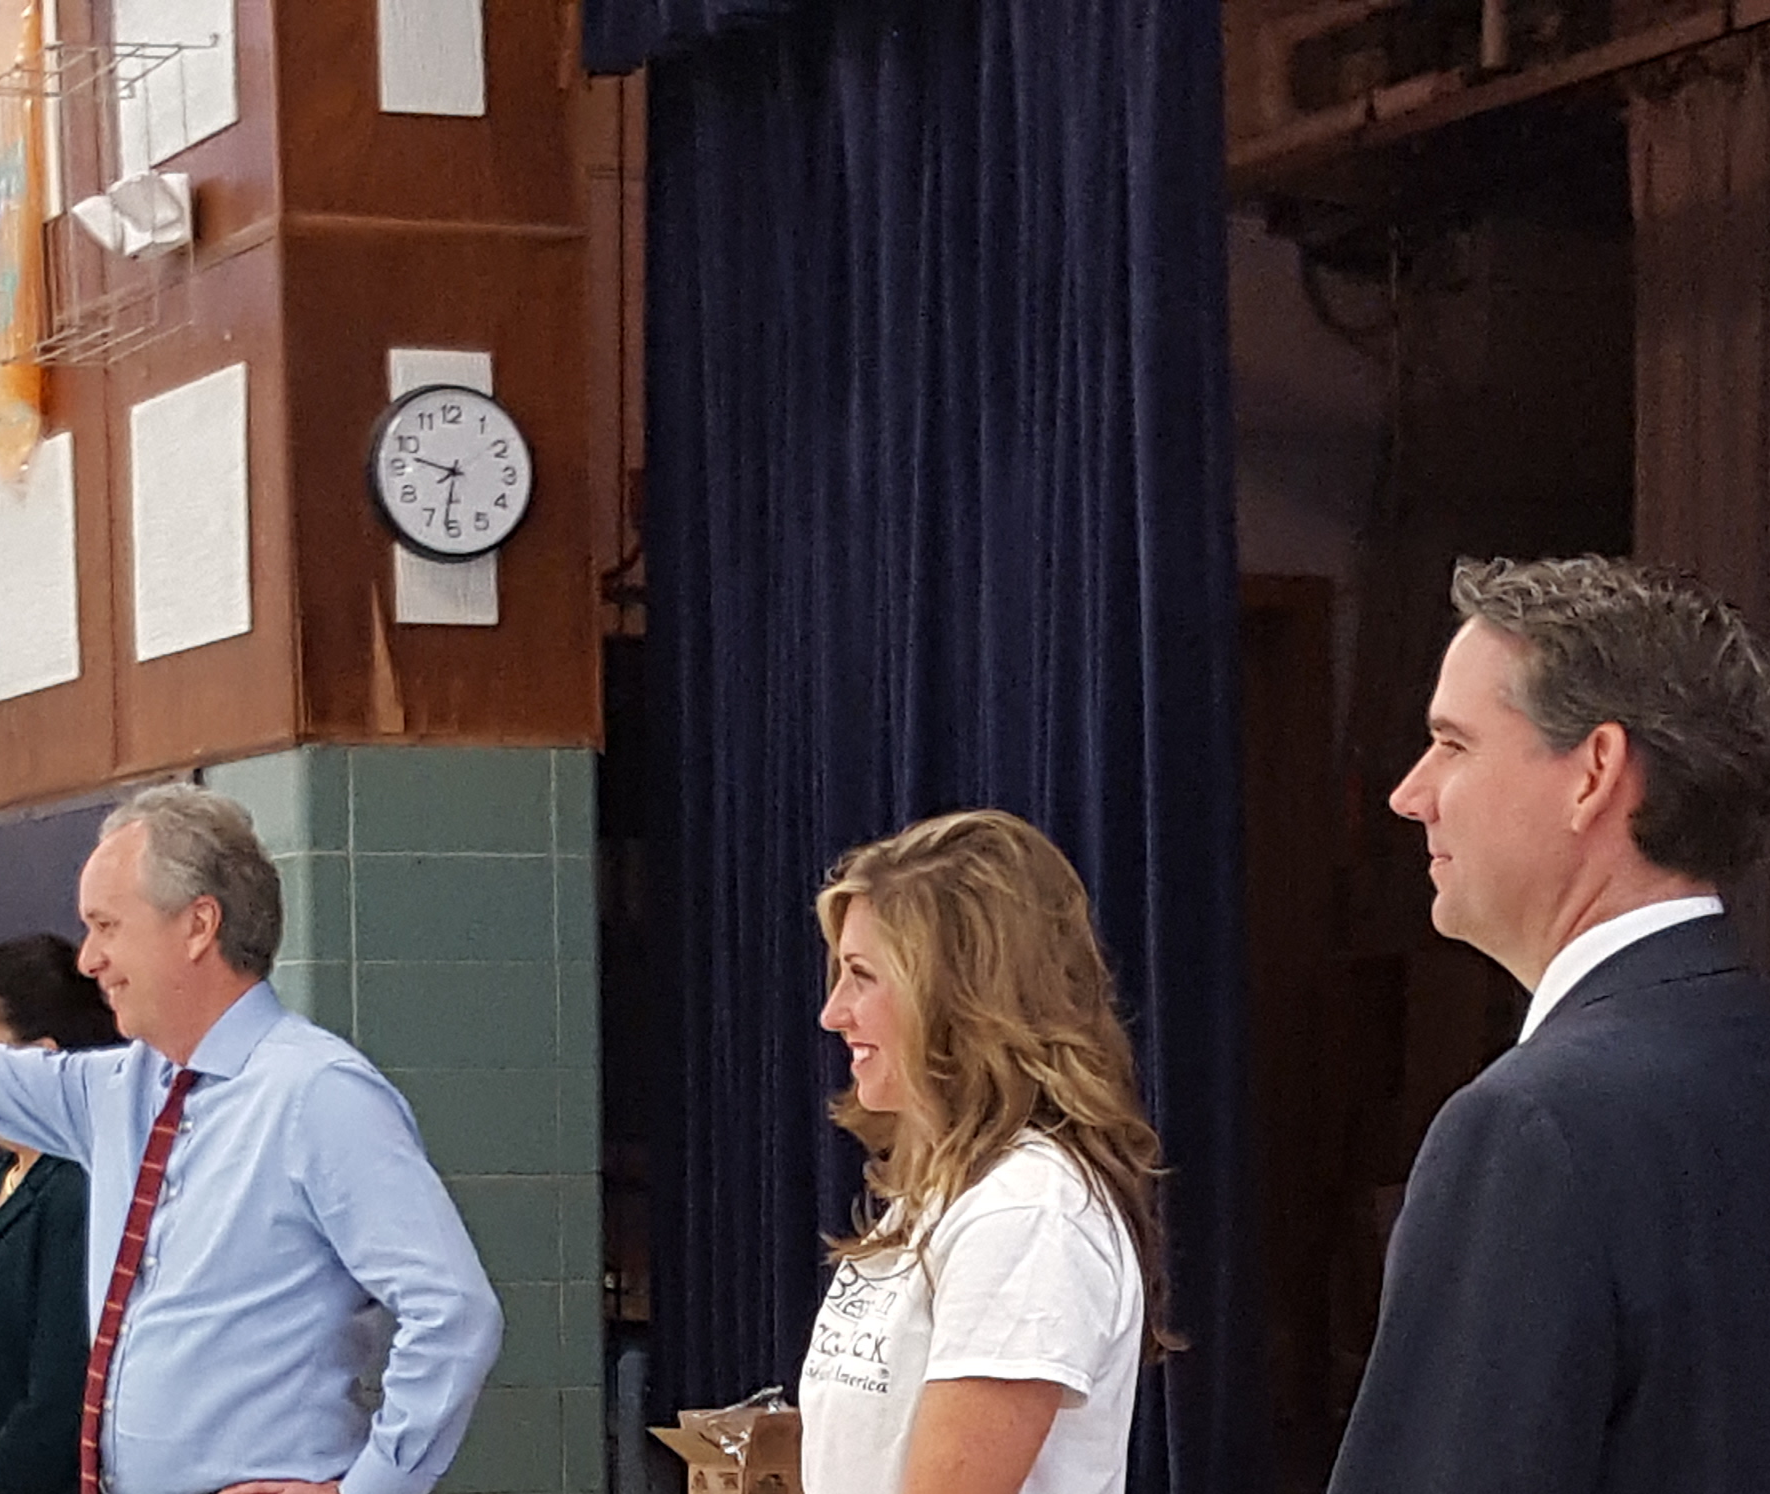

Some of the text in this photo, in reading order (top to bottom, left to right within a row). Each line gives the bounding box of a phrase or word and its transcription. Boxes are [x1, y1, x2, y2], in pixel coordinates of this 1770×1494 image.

[418, 413, 434, 430] 11
[441, 404, 462, 424] 12
[479, 415, 487, 434] 1
[397, 435, 419, 453] 10
[491, 440, 508, 458] 2
[391, 458, 406, 476] 9
[503, 466, 517, 486] 3
[400, 485, 417, 503] 8
[494, 493, 508, 509] 4
[423, 508, 435, 527] 7
[474, 512, 489, 531] 5
[446, 519, 461, 538] 6
